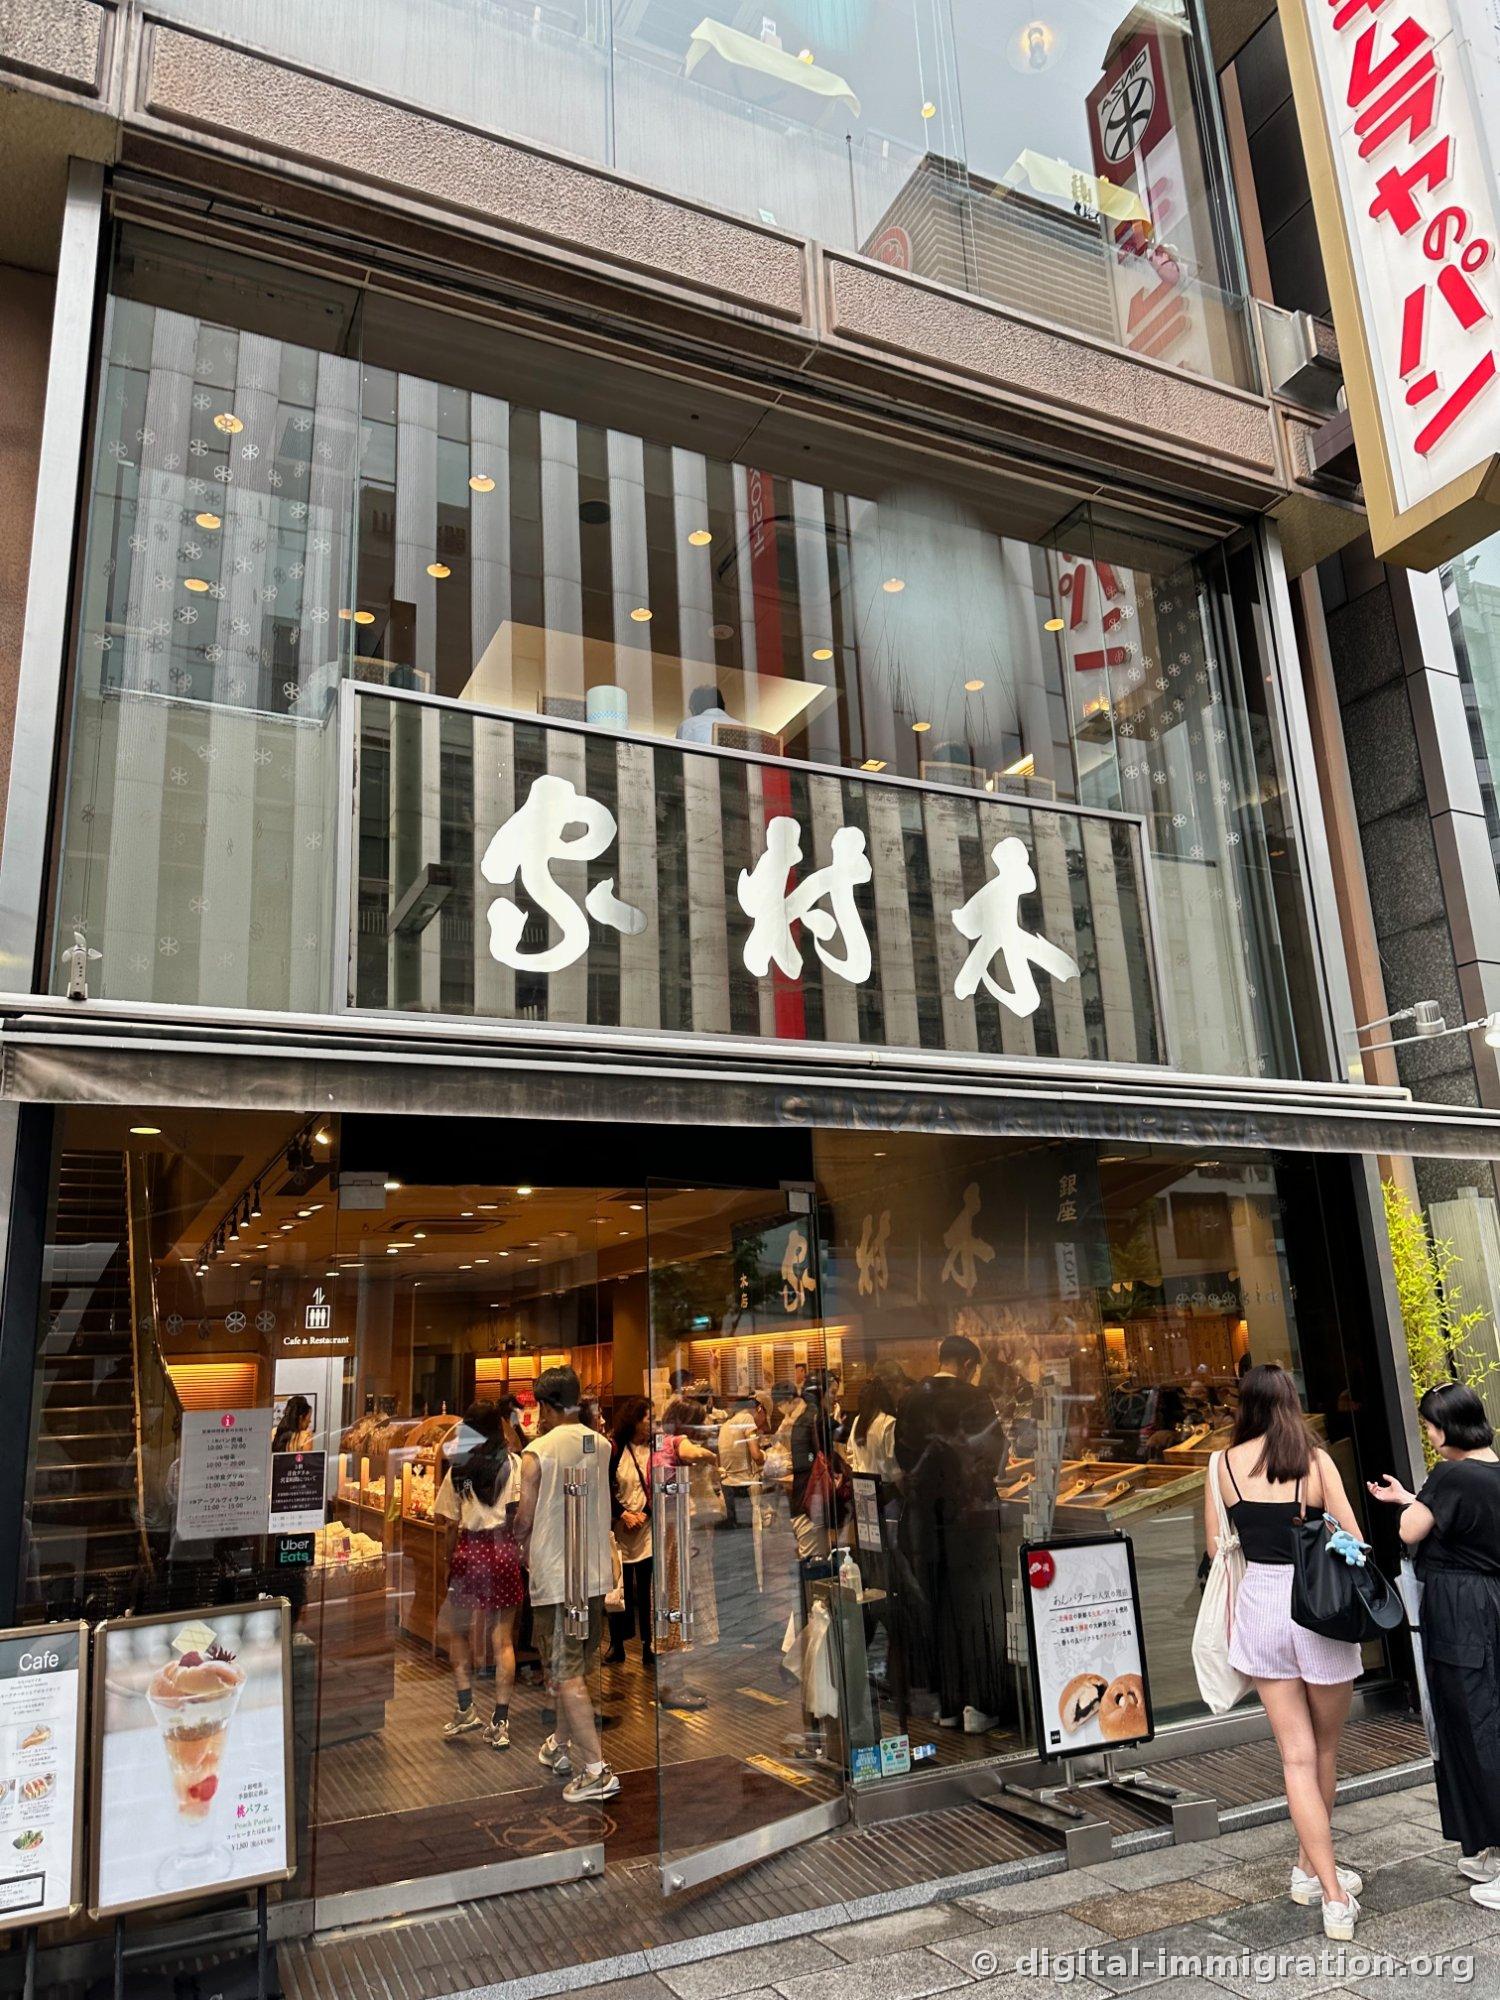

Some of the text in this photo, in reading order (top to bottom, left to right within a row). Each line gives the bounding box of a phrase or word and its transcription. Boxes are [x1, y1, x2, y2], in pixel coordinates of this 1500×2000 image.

[1056, 1173, 1079, 1223] 銀座
[283, 1337, 301, 1345] Cafe
[310, 1336, 349, 1344] Restaurant
[280, 1539, 310, 1550] Uber
[280, 1552, 309, 1564] Eats
[19, 1650, 59, 1671] Cafe
[236, 1804, 269, 1818] 桃パフェ
